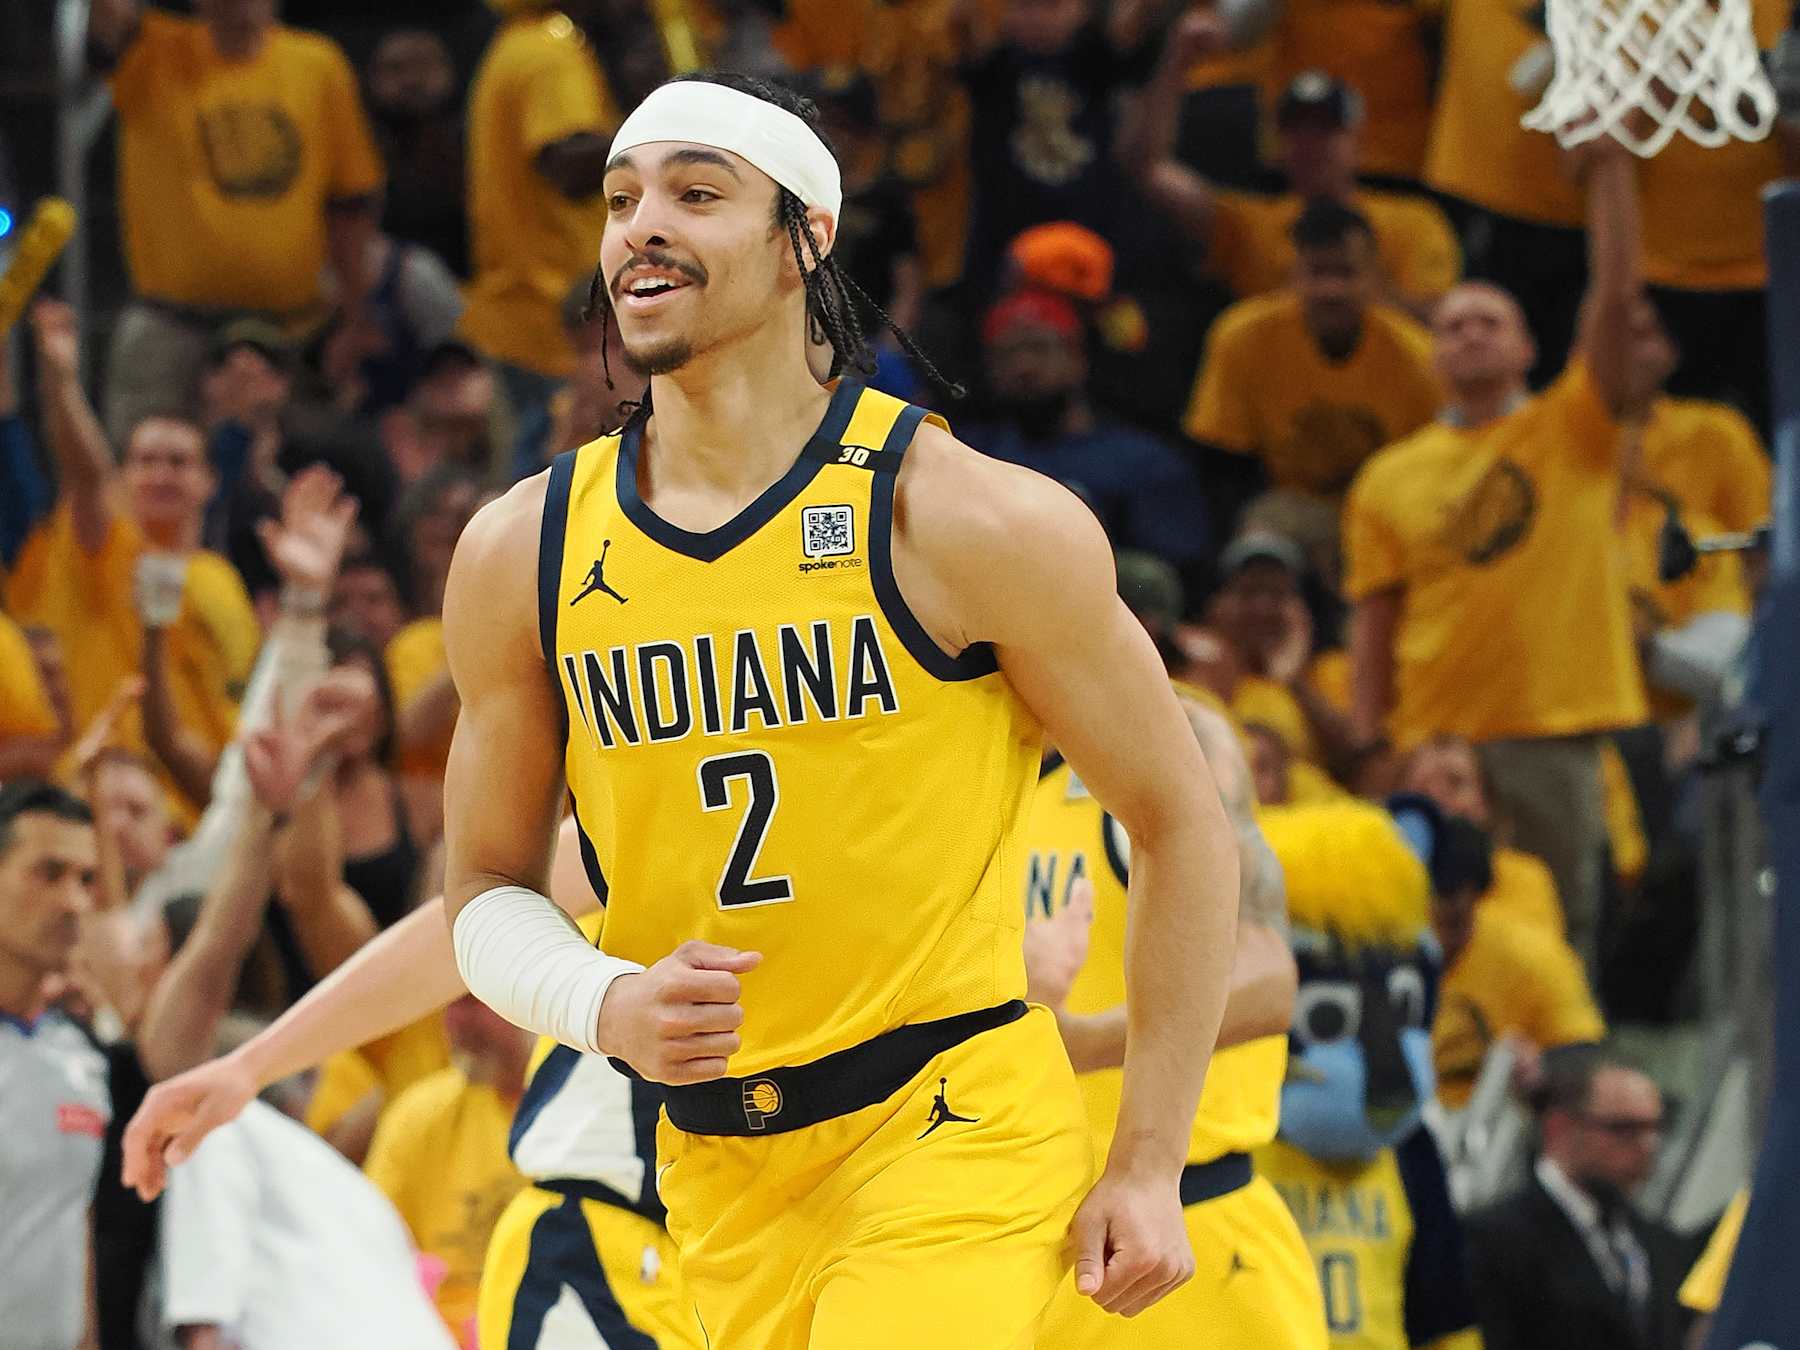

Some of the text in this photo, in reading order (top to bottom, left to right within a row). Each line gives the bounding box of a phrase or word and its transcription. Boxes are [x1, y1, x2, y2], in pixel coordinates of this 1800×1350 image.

[838, 446, 870, 466] 30
[799, 558, 862, 574] spokenote
[564, 614, 900, 749] INDIANA
[696, 749, 795, 911] 2
